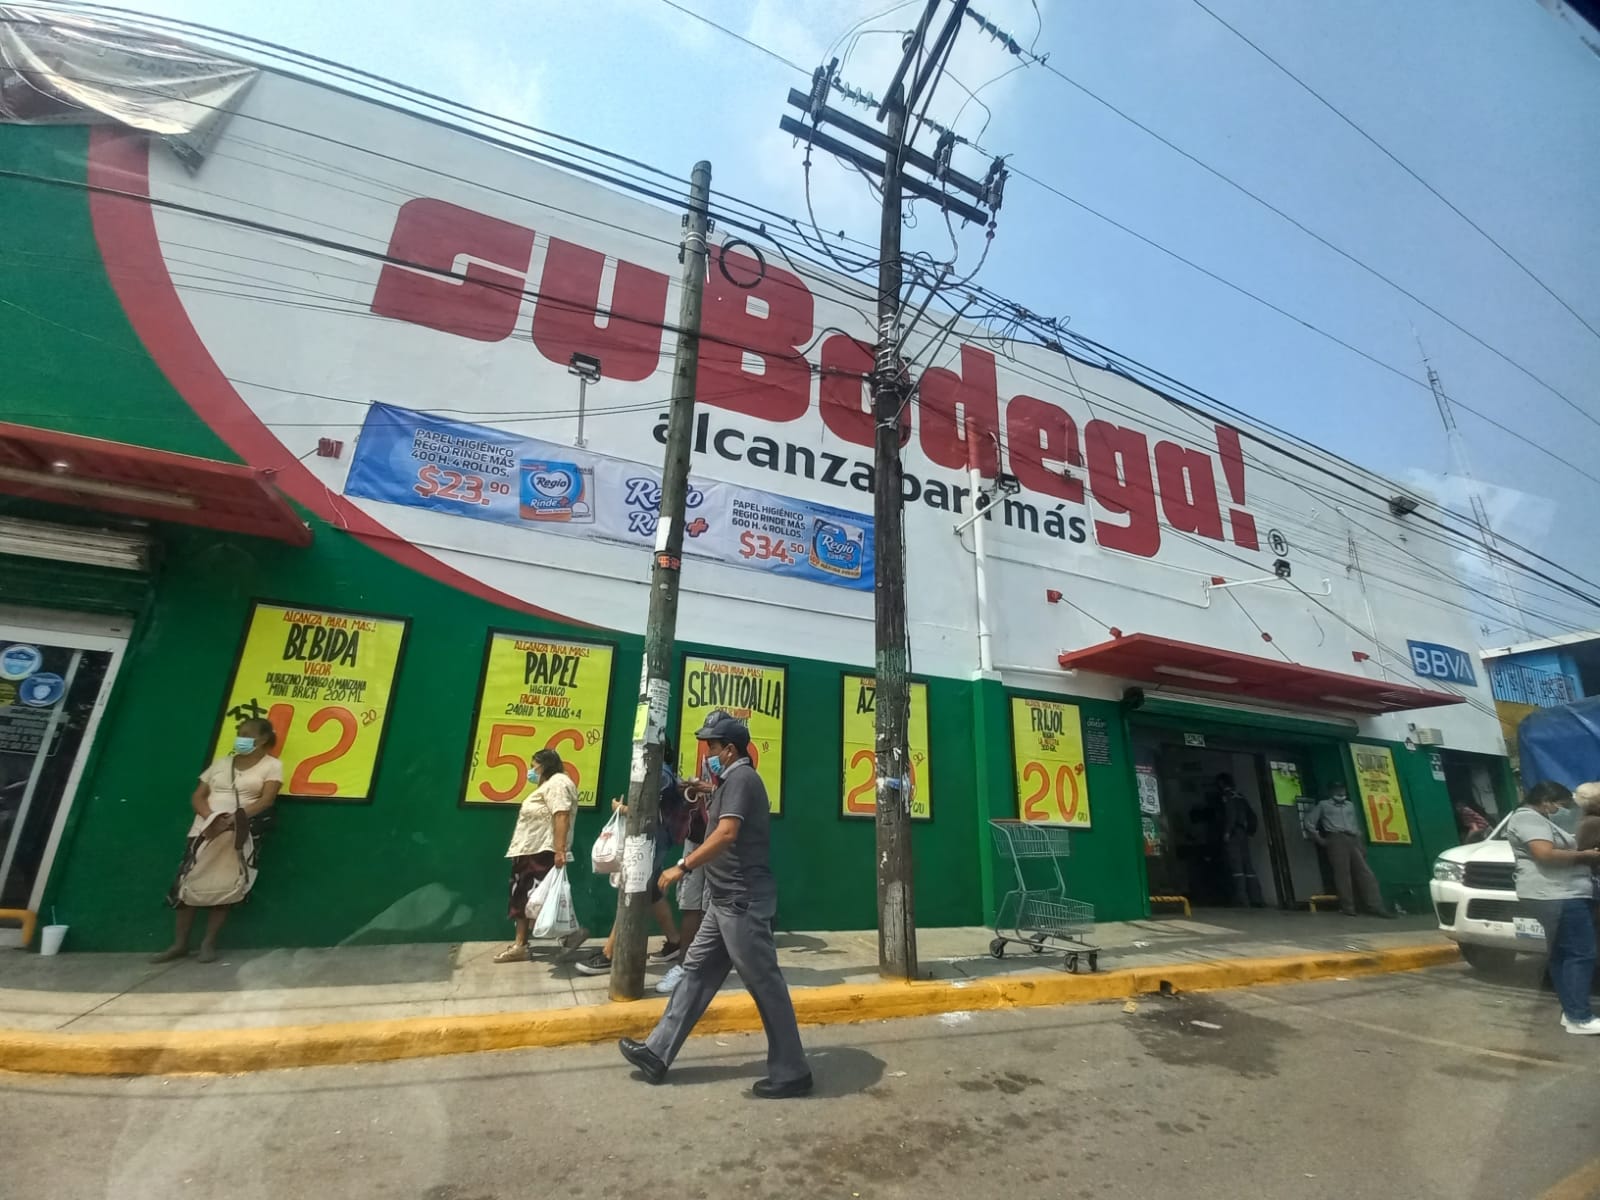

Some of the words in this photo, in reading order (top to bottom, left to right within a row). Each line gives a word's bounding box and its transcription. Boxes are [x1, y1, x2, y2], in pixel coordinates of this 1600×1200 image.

[414, 439, 450, 454] REGIO
[452, 447, 488, 462] RINDE
[490, 453, 515, 468] MÁS
[416, 429, 452, 445] PAPEL
[456, 437, 514, 457] HIGIÉNICO
[411, 451, 436, 462] 400
[452, 458, 460, 467] 4
[535, 476, 567, 490] Regio
[625, 477, 704, 512] Reo
[732, 517, 750, 528] 600
[762, 524, 768, 532] 4
[733, 500, 760, 512] PAPEL
[762, 505, 804, 521] HIGIÉNICO
[733, 508, 759, 520] REGIO
[760, 514, 786, 526] RINDE
[787, 518, 806, 530] MÁS
[1003, 498, 1087, 544] más
[822, 533, 854, 554] Regio
[283, 610, 322, 625] ALCANZA
[325, 616, 347, 629] PARA
[282, 622, 360, 668] BEBIDA
[304, 661, 332, 676] VIGOR
[524, 651, 580, 689] PAPEL
[1411, 646, 1474, 680] BBVA
[267, 683, 289, 697] MINI
[291, 685, 319, 700] BRICK
[323, 688, 346, 701] 200
[529, 684, 566, 696] HIGIENICO
[687, 670, 781, 720] SERVITOALLA
[1031, 707, 1065, 736] FRIJOL
[1023, 762, 1079, 822] 20
[1367, 794, 1400, 841] 12
